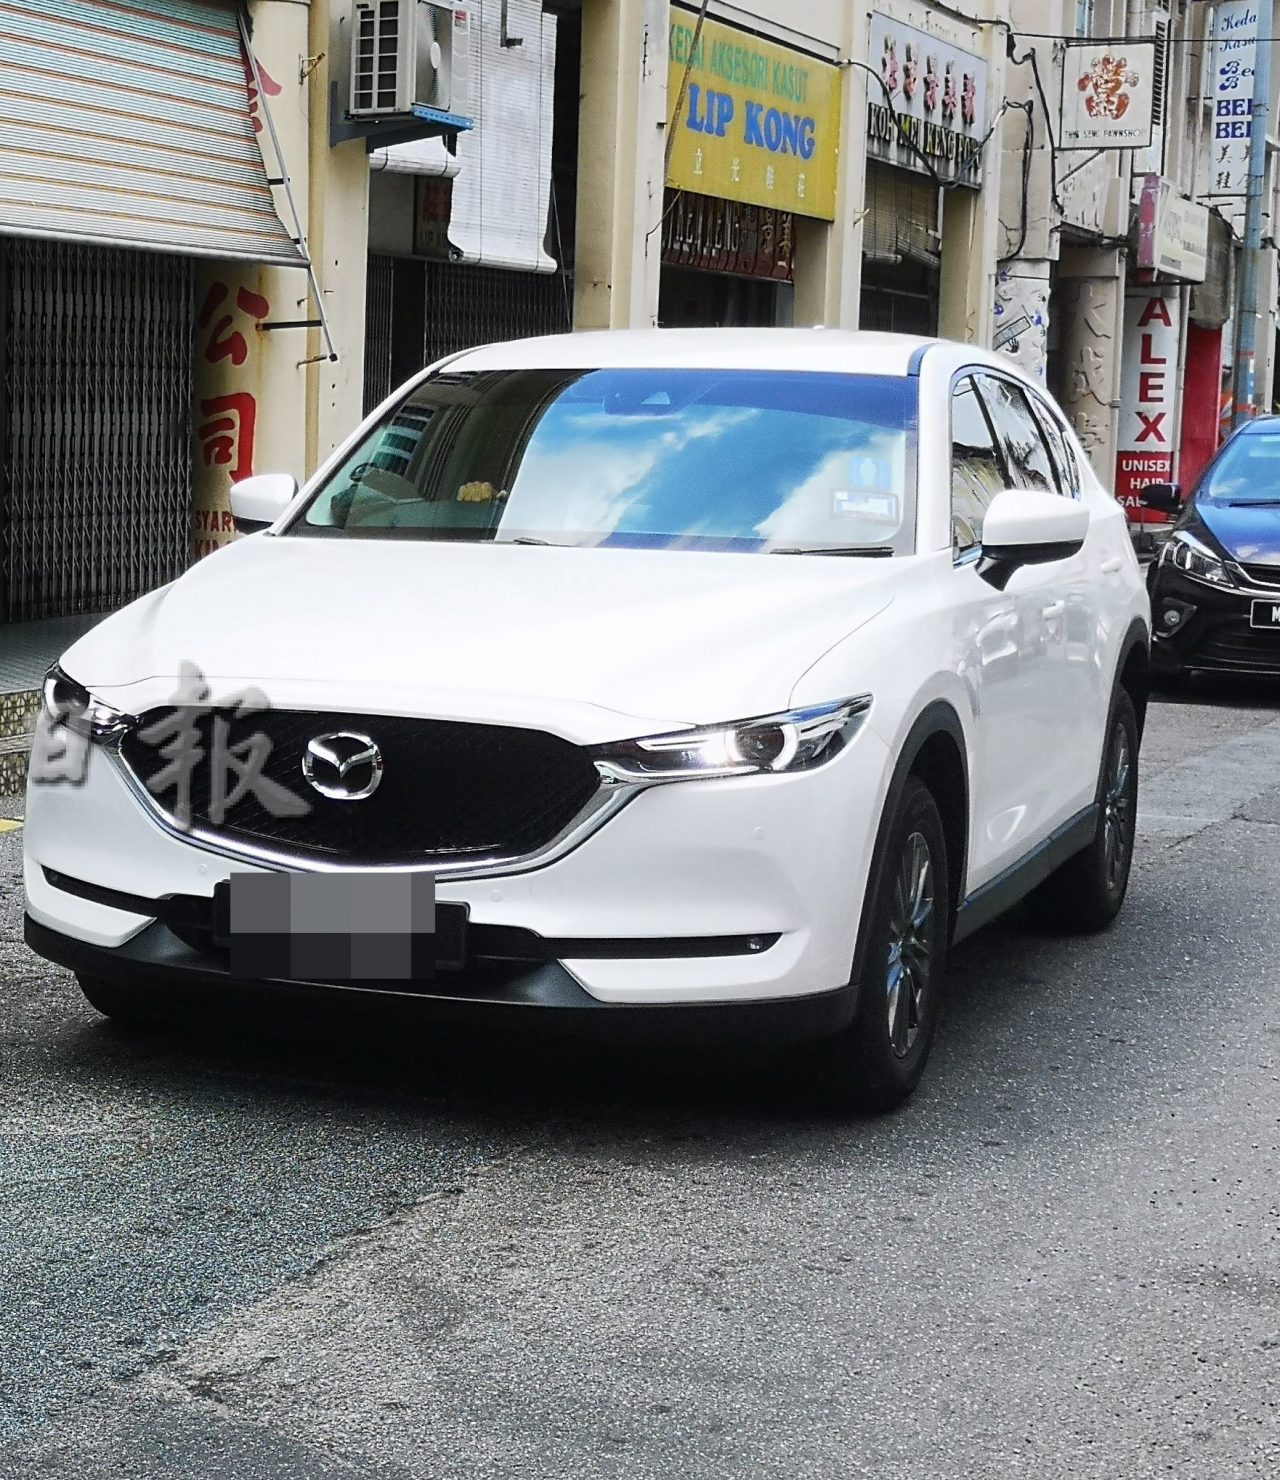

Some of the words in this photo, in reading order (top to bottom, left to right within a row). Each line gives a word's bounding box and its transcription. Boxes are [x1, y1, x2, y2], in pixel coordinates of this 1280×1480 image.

[1220, 9, 1257, 32] Keda
[1220, 37, 1256, 52] Kasu
[772, 61, 809, 104] KASUT
[687, 82, 734, 137] LIP
[744, 100, 816, 160] KONG
[1134, 297, 1172, 442] ALEX
[1122, 460, 1170, 471] UNISEX
[1117, 496, 1142, 507] SAL
[195, 511, 236, 532] SYAR
